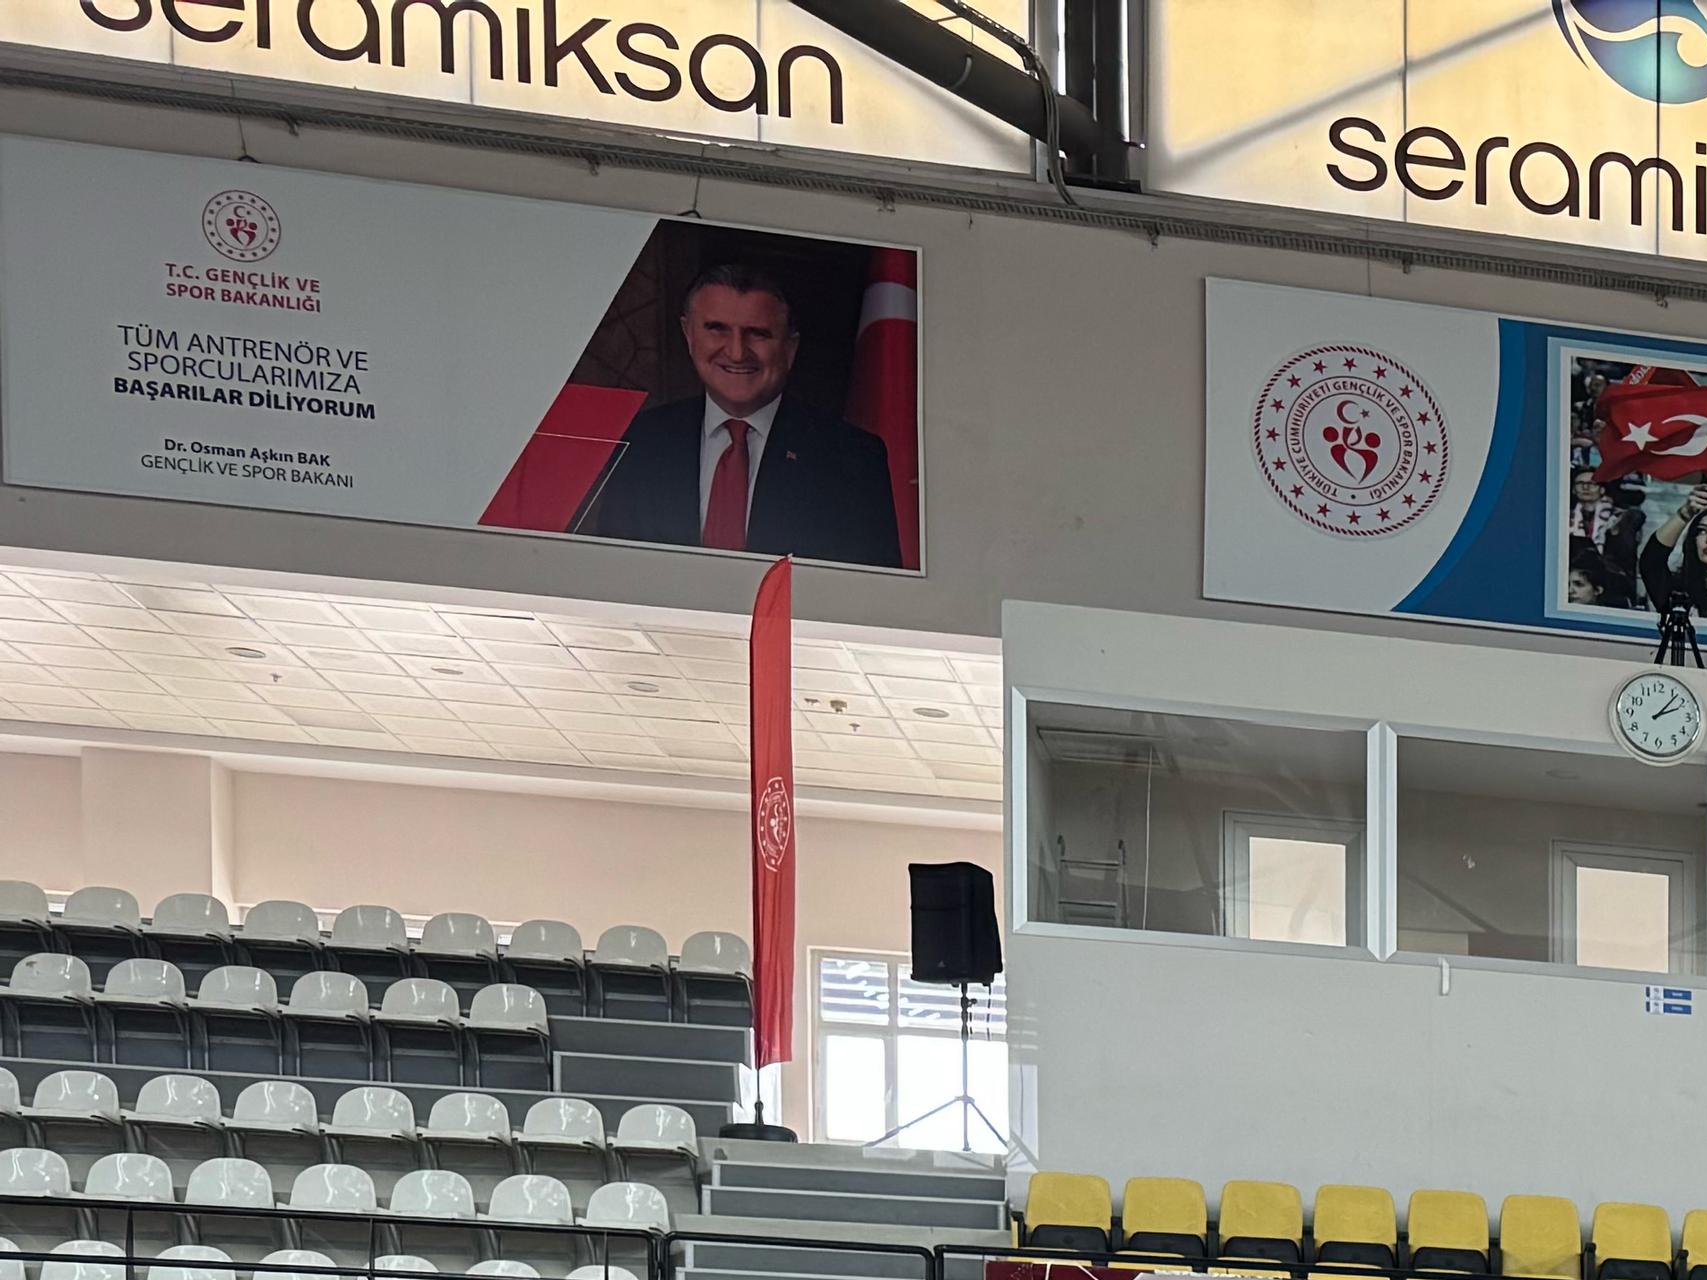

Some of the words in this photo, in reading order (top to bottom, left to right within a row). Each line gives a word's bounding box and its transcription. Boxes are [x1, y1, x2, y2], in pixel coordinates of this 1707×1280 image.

[164, 263, 199, 281] T.C.
[205, 267, 290, 290] GENÇLİK
[296, 277, 321, 293] VE
[166, 283, 215, 301] SPOR
[221, 288, 321, 313] BAKANLIĞI
[117, 323, 179, 351] TÜM
[187, 332, 331, 367] ANTRENÖR
[336, 349, 369, 372] VE
[127, 351, 361, 395] SPORCULARIMIZA
[113, 377, 243, 406] BAŞARILAR
[249, 388, 376, 420] DİLİYORUM
[1385, 398, 1400, 414] VE
[1395, 415, 1413, 446] SPOR
[164, 438, 187, 452] Dr.
[190, 441, 246, 459] Osman
[249, 447, 294, 464] Aşkın
[297, 451, 331, 467] BAK
[140, 454, 213, 475] GENÇLİK
[216, 462, 239, 477] VE
[242, 464, 287, 482] SPOR
[291, 468, 354, 489] BAKANI
[1653, 683, 1665, 693] 12
[1631, 696, 1643, 706] 10
[1626, 707, 1634, 718] 9
[1685, 712, 1692, 723] 3
[1630, 722, 1639, 731] 8
[1679, 726, 1686, 735] 4
[1642, 732, 1649, 742] 7
[1654, 737, 1663, 749] 6
[1671, 734, 1678, 746] 5
